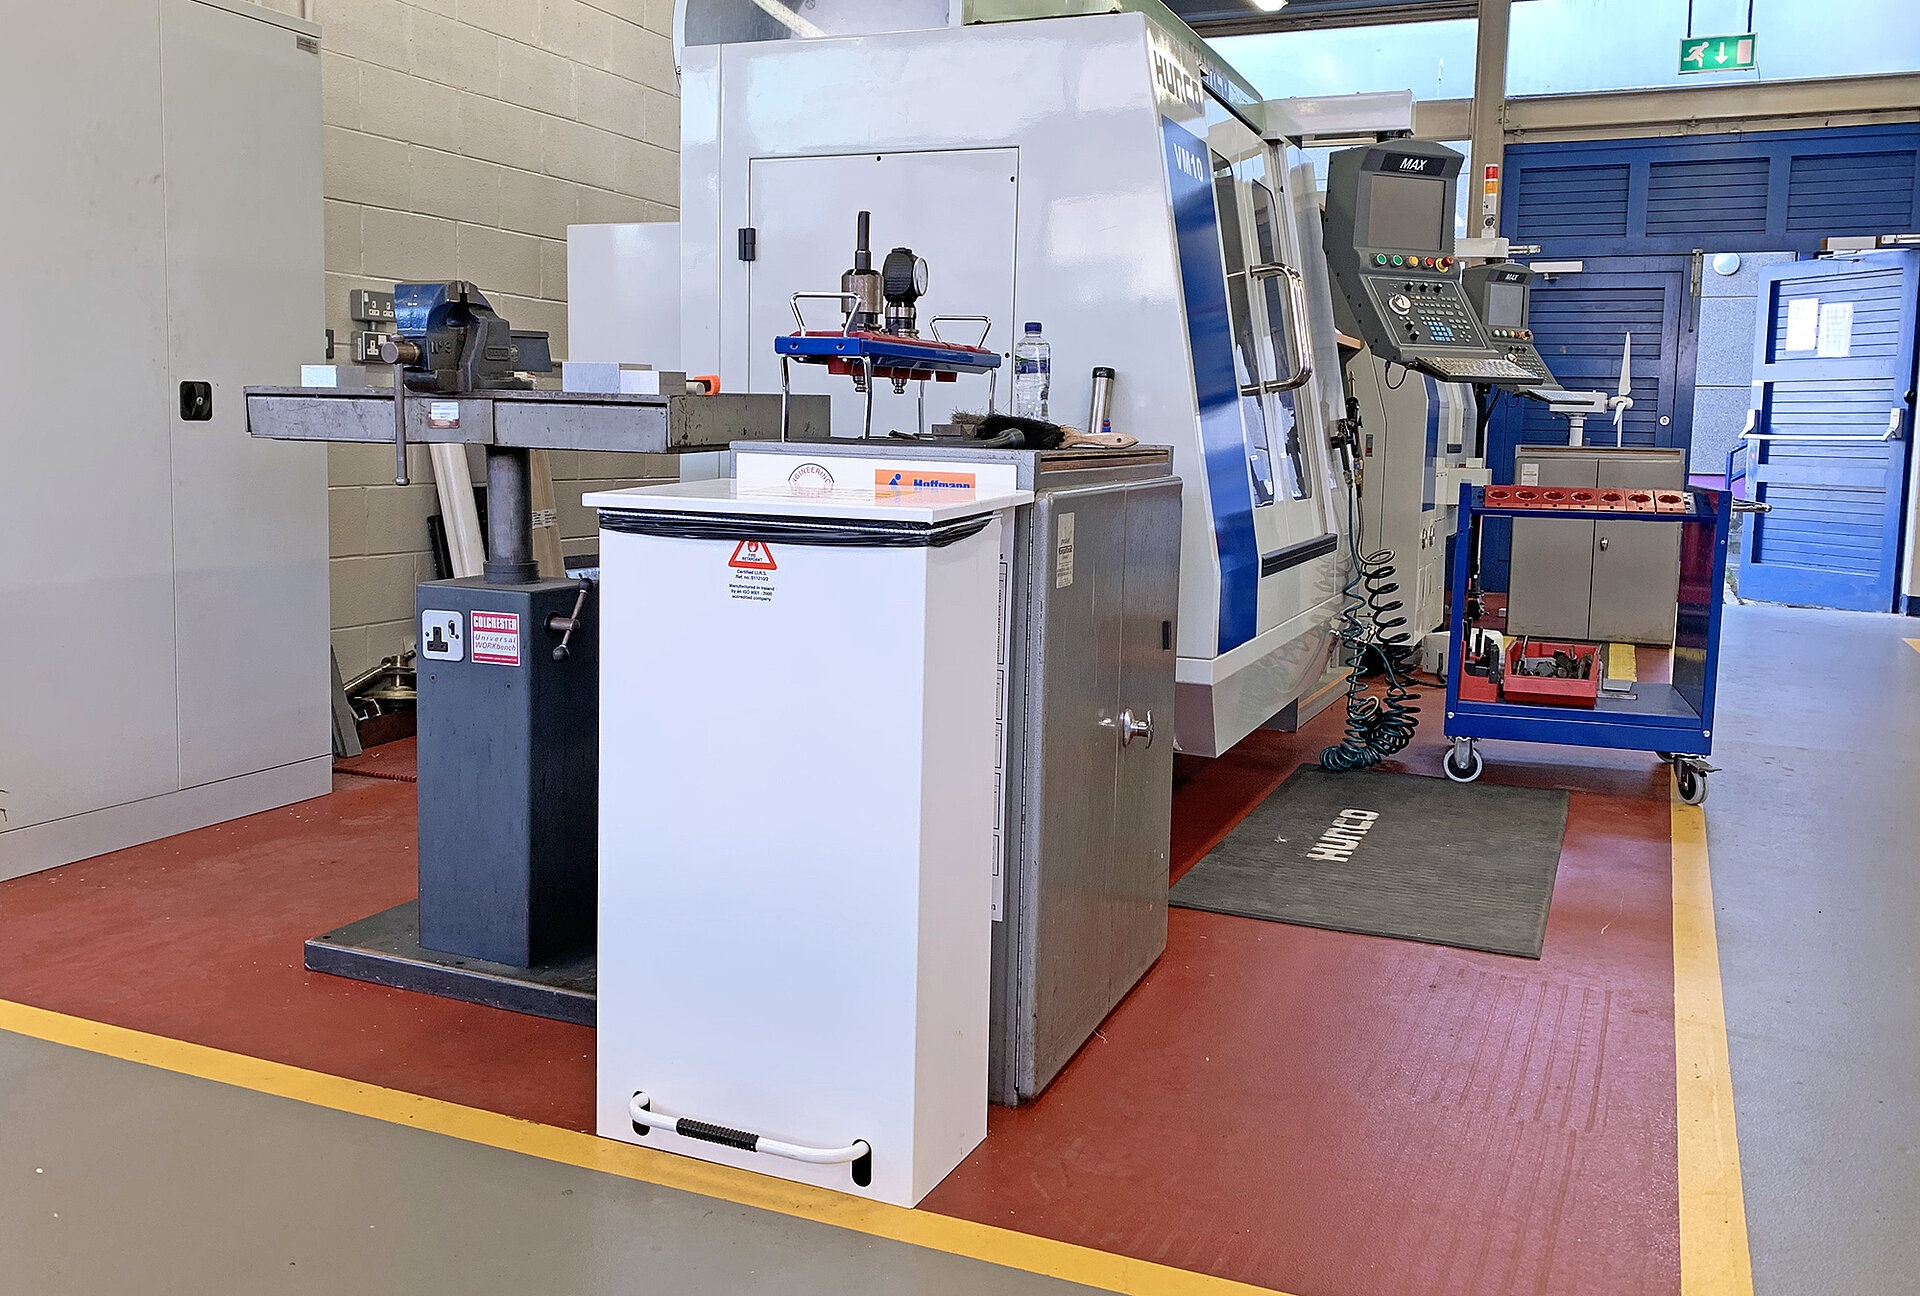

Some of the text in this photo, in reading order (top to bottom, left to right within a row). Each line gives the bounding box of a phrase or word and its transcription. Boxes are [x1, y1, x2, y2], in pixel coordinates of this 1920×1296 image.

[1153, 50, 1204, 114] HURCO
[1173, 142, 1204, 183] VM10
[1400, 157, 1427, 171] MAX
[1505, 273, 1519, 281] MAX
[473, 616, 517, 631] COLCHESTER
[475, 633, 517, 643] Universal
[475, 641, 516, 651] WORKbench
[1306, 809, 1380, 862] HURCO
